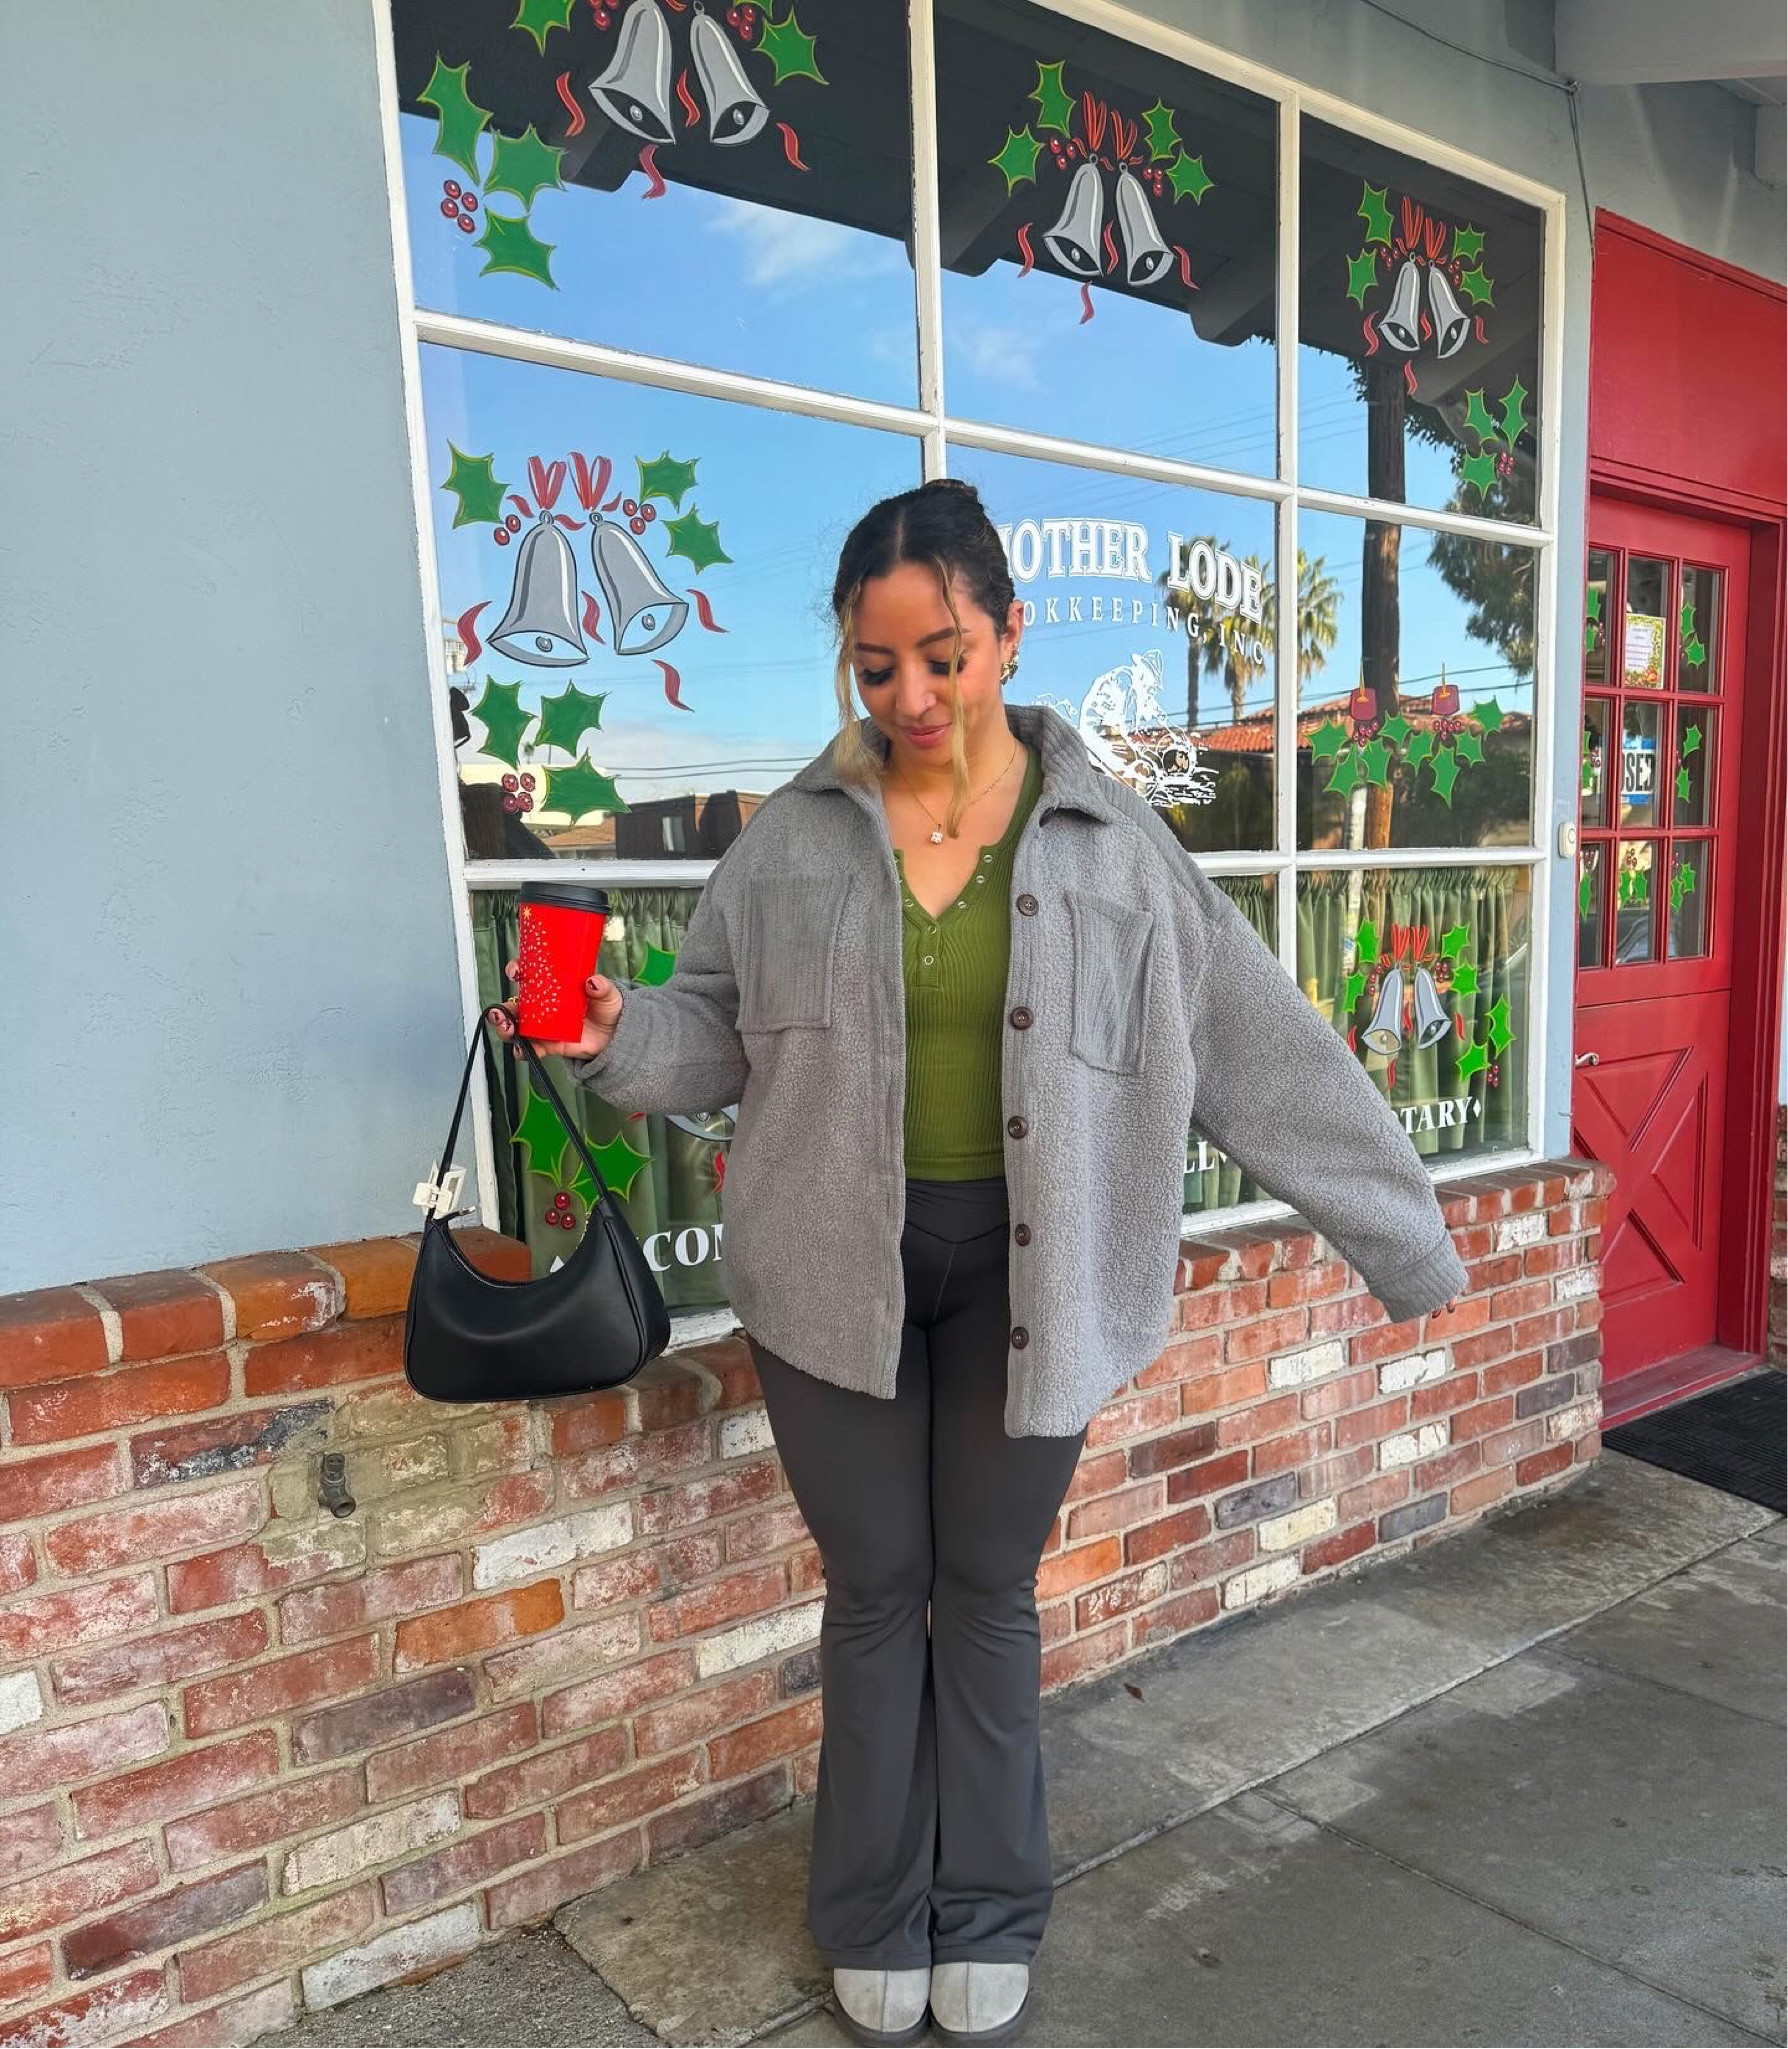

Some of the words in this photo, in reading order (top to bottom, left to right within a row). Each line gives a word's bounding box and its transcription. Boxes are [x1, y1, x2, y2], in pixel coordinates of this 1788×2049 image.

[1167, 531, 1262, 624] LODE
[1219, 623, 1263, 665] INC
[1621, 752, 1656, 792] SED
[1391, 1096, 1473, 1134] TARY
